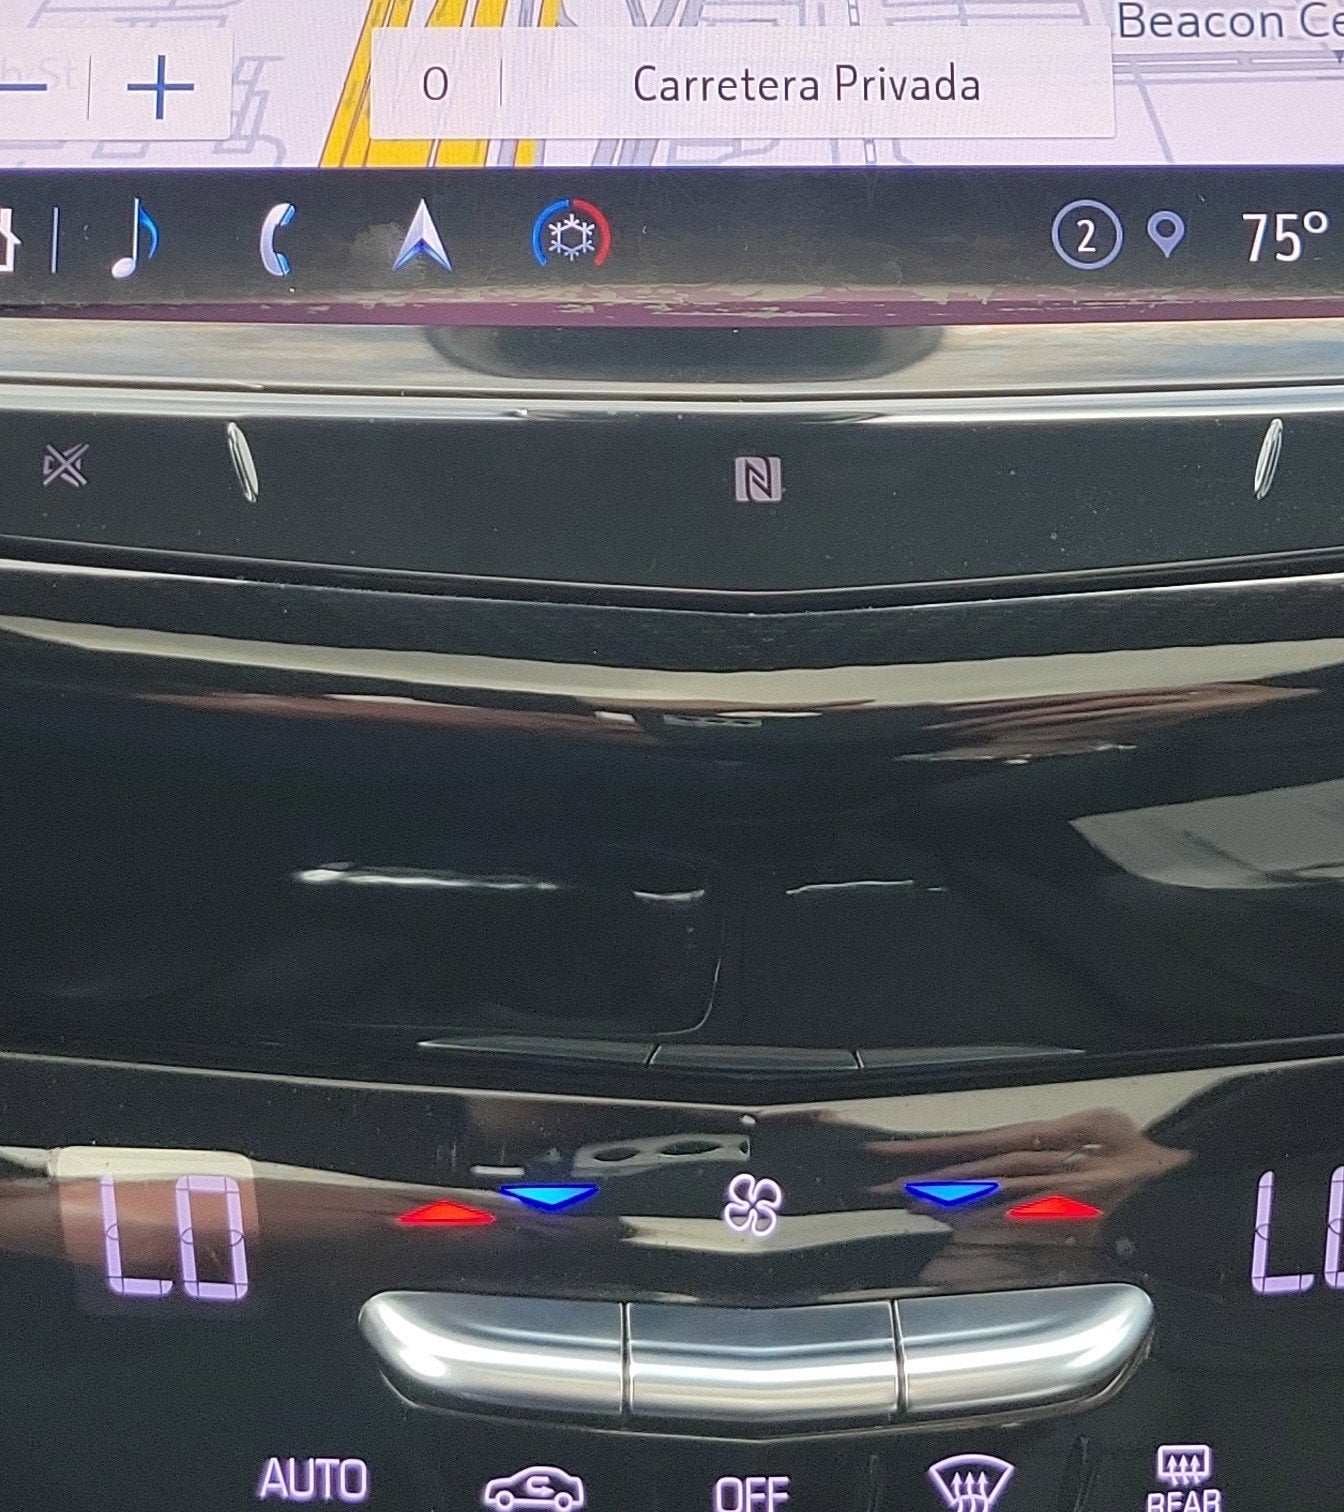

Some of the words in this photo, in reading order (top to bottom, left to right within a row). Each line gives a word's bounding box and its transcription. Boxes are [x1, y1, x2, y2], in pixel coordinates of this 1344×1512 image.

[1118, 1, 1284, 39] Beacon
[634, 64, 820, 102] Carretera
[835, 61, 981, 101] Privada
[1076, 219, 1097, 253] 2
[258, 1456, 369, 1502] AUTO
[714, 1476, 791, 1512] OFF
